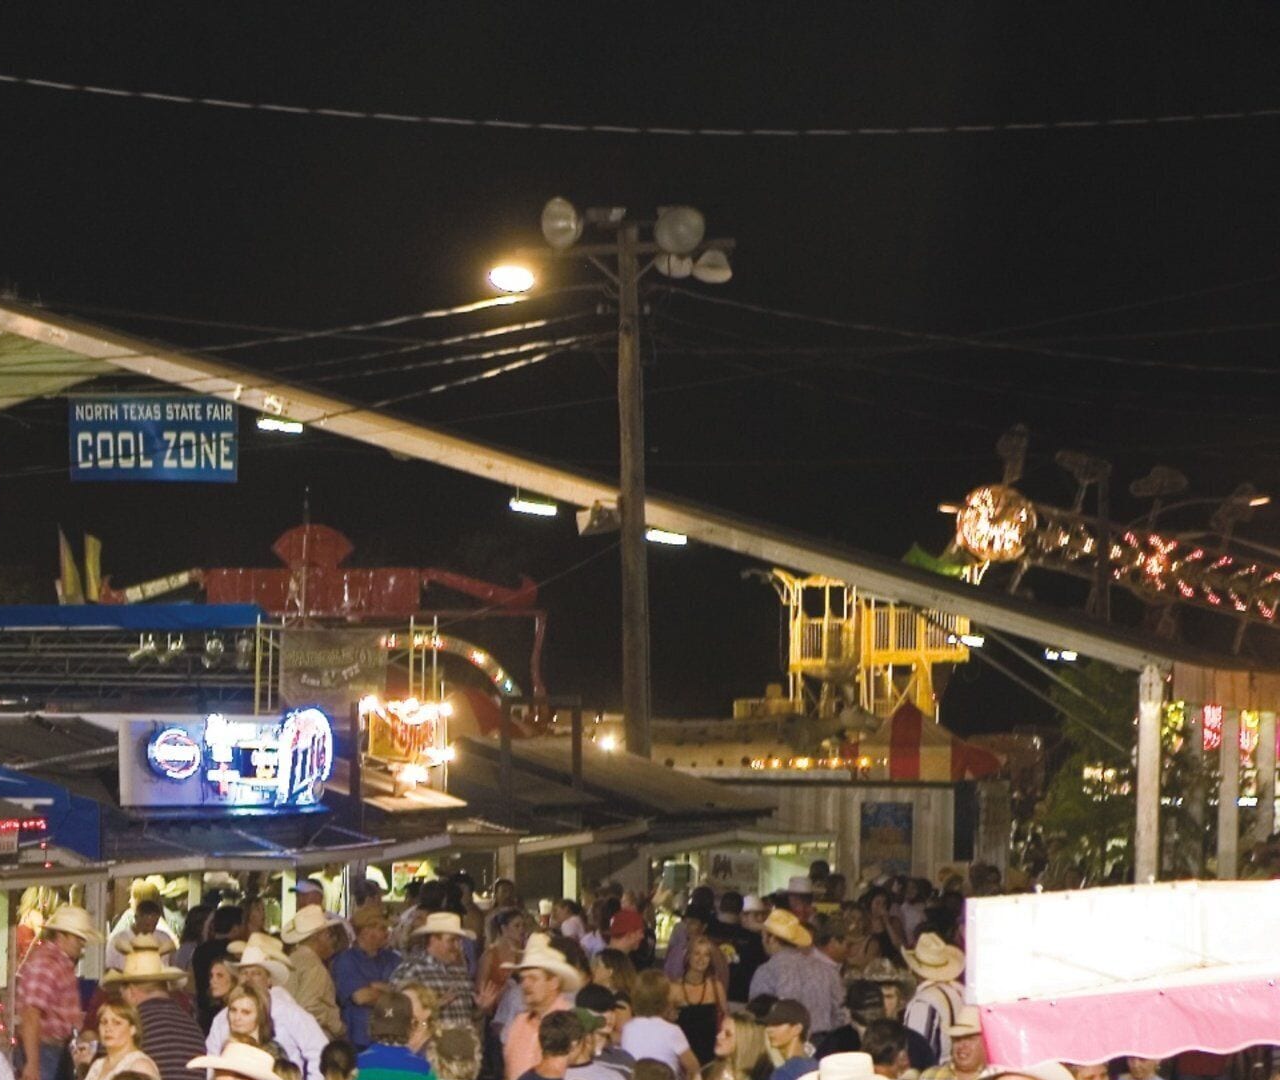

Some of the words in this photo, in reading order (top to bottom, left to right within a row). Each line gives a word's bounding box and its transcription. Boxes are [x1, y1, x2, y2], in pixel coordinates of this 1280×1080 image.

[75, 404, 118, 421] NORTH
[122, 404, 161, 421] TEXAS
[166, 403, 202, 422] STATE
[206, 403, 233, 422] FAIR
[76, 431, 153, 469] COOL
[162, 431, 233, 470] ZONE
